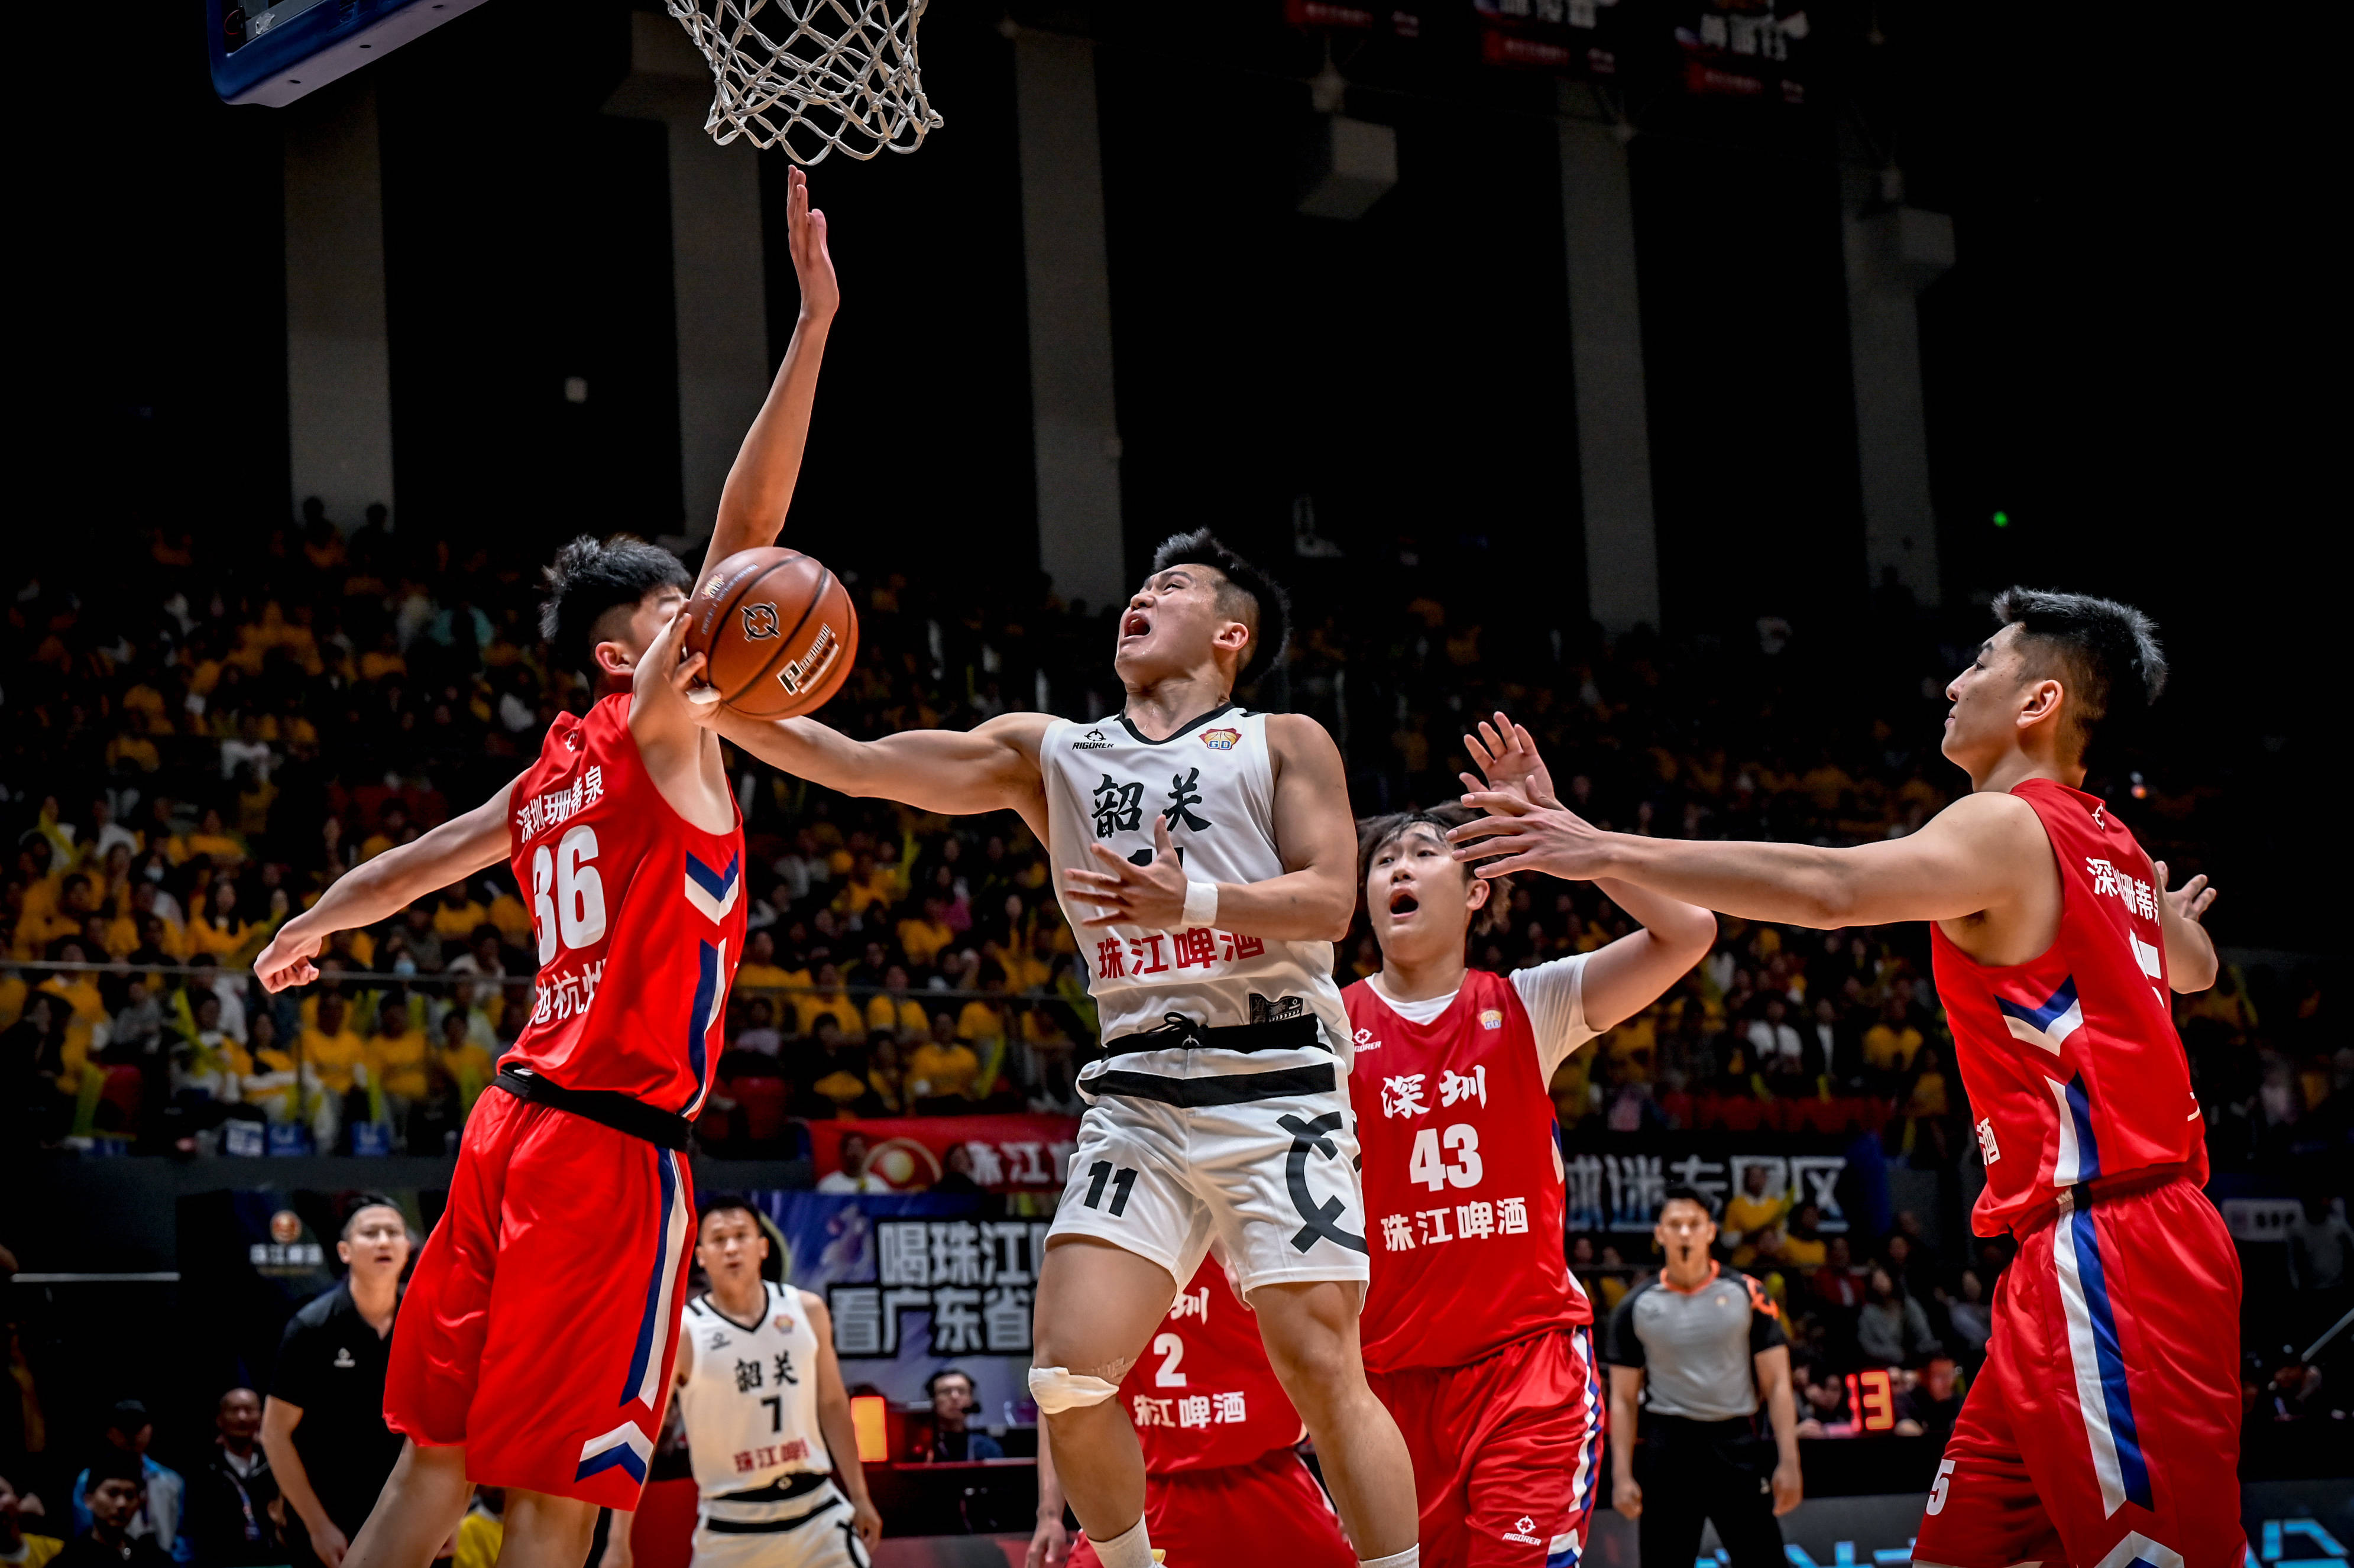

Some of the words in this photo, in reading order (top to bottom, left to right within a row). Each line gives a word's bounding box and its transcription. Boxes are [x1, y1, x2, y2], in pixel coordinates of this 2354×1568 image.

[1209, 740, 1231, 749] GD
[516, 765, 604, 844] 深圳珊蒂泉
[1092, 767, 1212, 838] 韶关
[533, 825, 607, 967] 36
[1381, 1065, 1487, 1119] 深圳
[1410, 1123, 1483, 1192] 43
[1083, 1159, 1138, 1217] 11
[1381, 1197, 1529, 1252] 珠江啤酒
[878, 1220, 1054, 1287] 喝珠江
[1153, 1333, 1187, 1388] 2
[761, 1396, 781, 1433] 7
[734, 1437, 810, 1472] 珠江啤
[1926, 1459, 1956, 1515] 5
[1502, 1533, 1542, 1546] RIGORER
